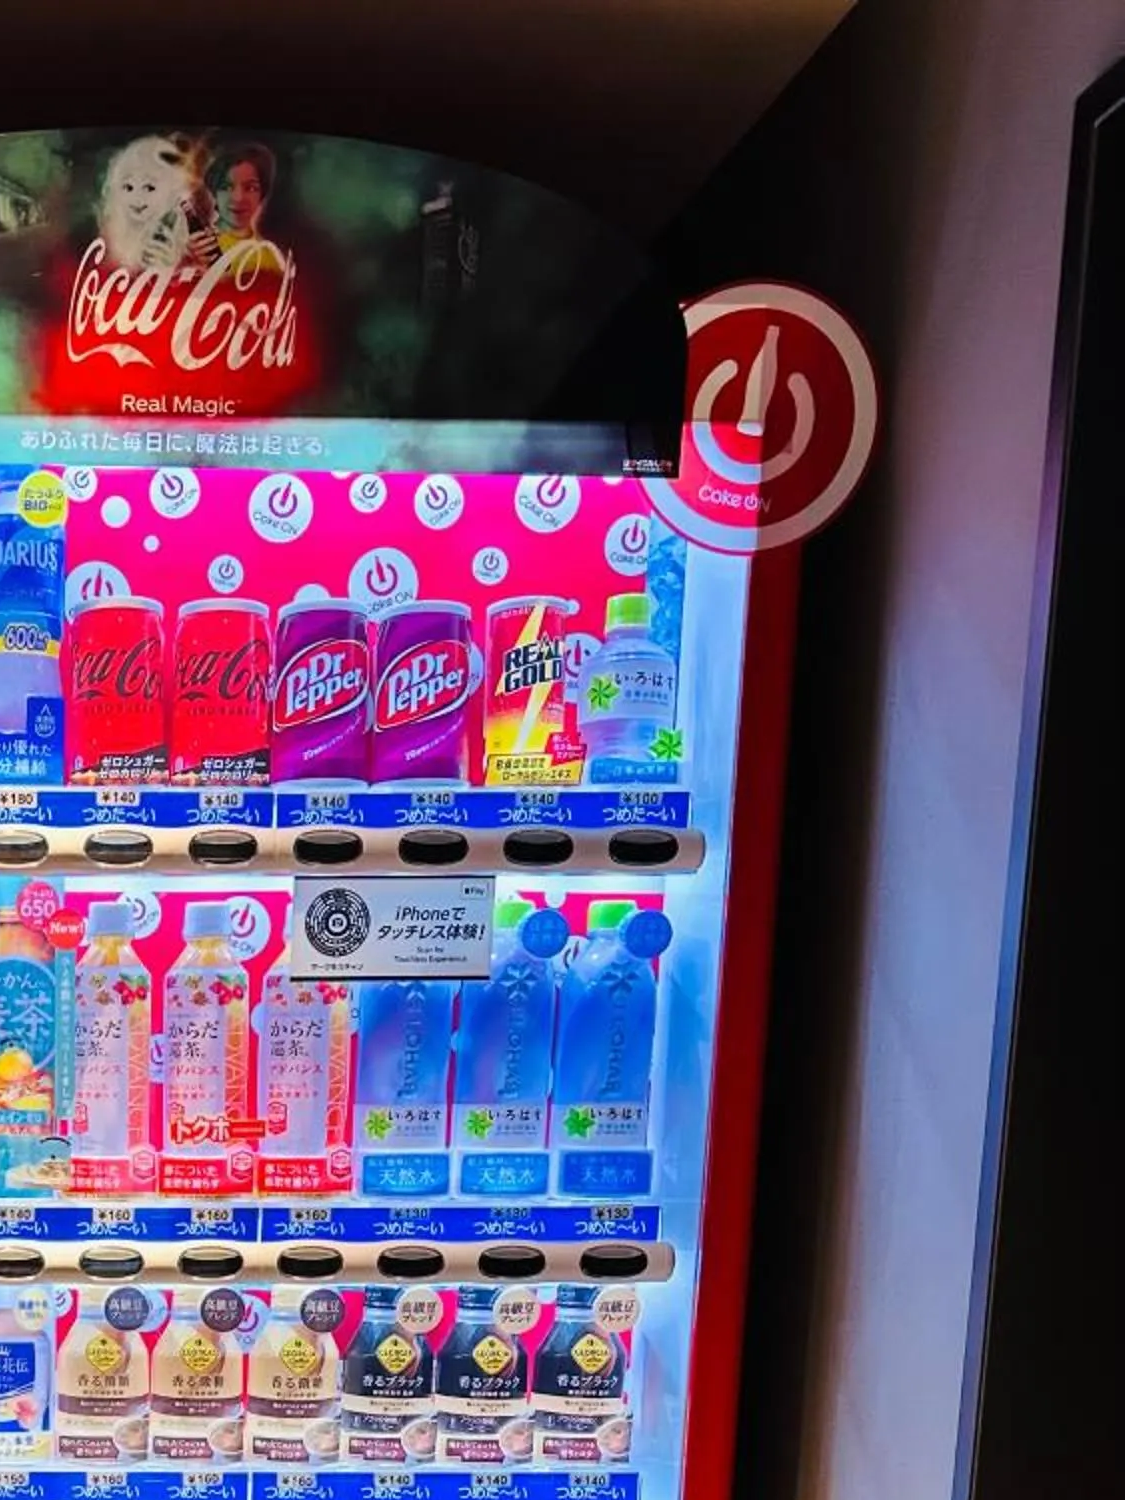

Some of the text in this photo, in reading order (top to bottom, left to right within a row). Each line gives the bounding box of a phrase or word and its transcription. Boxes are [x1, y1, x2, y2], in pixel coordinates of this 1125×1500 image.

[66, 238, 298, 372] Coca-Cola
[120, 393, 236, 417] Real Magic
[698, 483, 772, 513] Coke ON
[503, 634, 564, 674] REAL
[306, 650, 347, 680] Dr
[410, 652, 449, 682] Dr
[504, 659, 564, 695] GOLD
[284, 665, 363, 718] Pepper
[386, 667, 465, 720] Pepper
[100, 755, 166, 770] ゼロシュガー
[202, 756, 267, 770] ゼロシュガー
[0, 793, 33, 805] ¥180
[102, 792, 135, 803] ¥140
[204, 793, 238, 805] ¥140
[311, 796, 345, 808] ¥140
[416, 793, 450, 805] ¥140
[521, 793, 554, 805] ¥140
[624, 793, 659, 805] ¥100
[20, 901, 56, 917] 650
[394, 906, 466, 922] iPhoneで
[49, 922, 85, 935] New!
[377, 923, 485, 941] タッチレス体験!
[168, 1020, 219, 1039] からだ
[269, 1020, 324, 1039] からだ
[378, 1169, 436, 1185] 天然水
[478, 1168, 535, 1185] 天然水
[580, 1168, 637, 1185] 天然水
[362, 1375, 424, 1388] 香るブラック
[458, 1375, 520, 1389] 香るブラック
[557, 1375, 618, 1388] 香るブラック
[379, 1475, 411, 1485] ¥140
[476, 1475, 508, 1485] ¥140
[575, 1475, 606, 1485] ¥140
